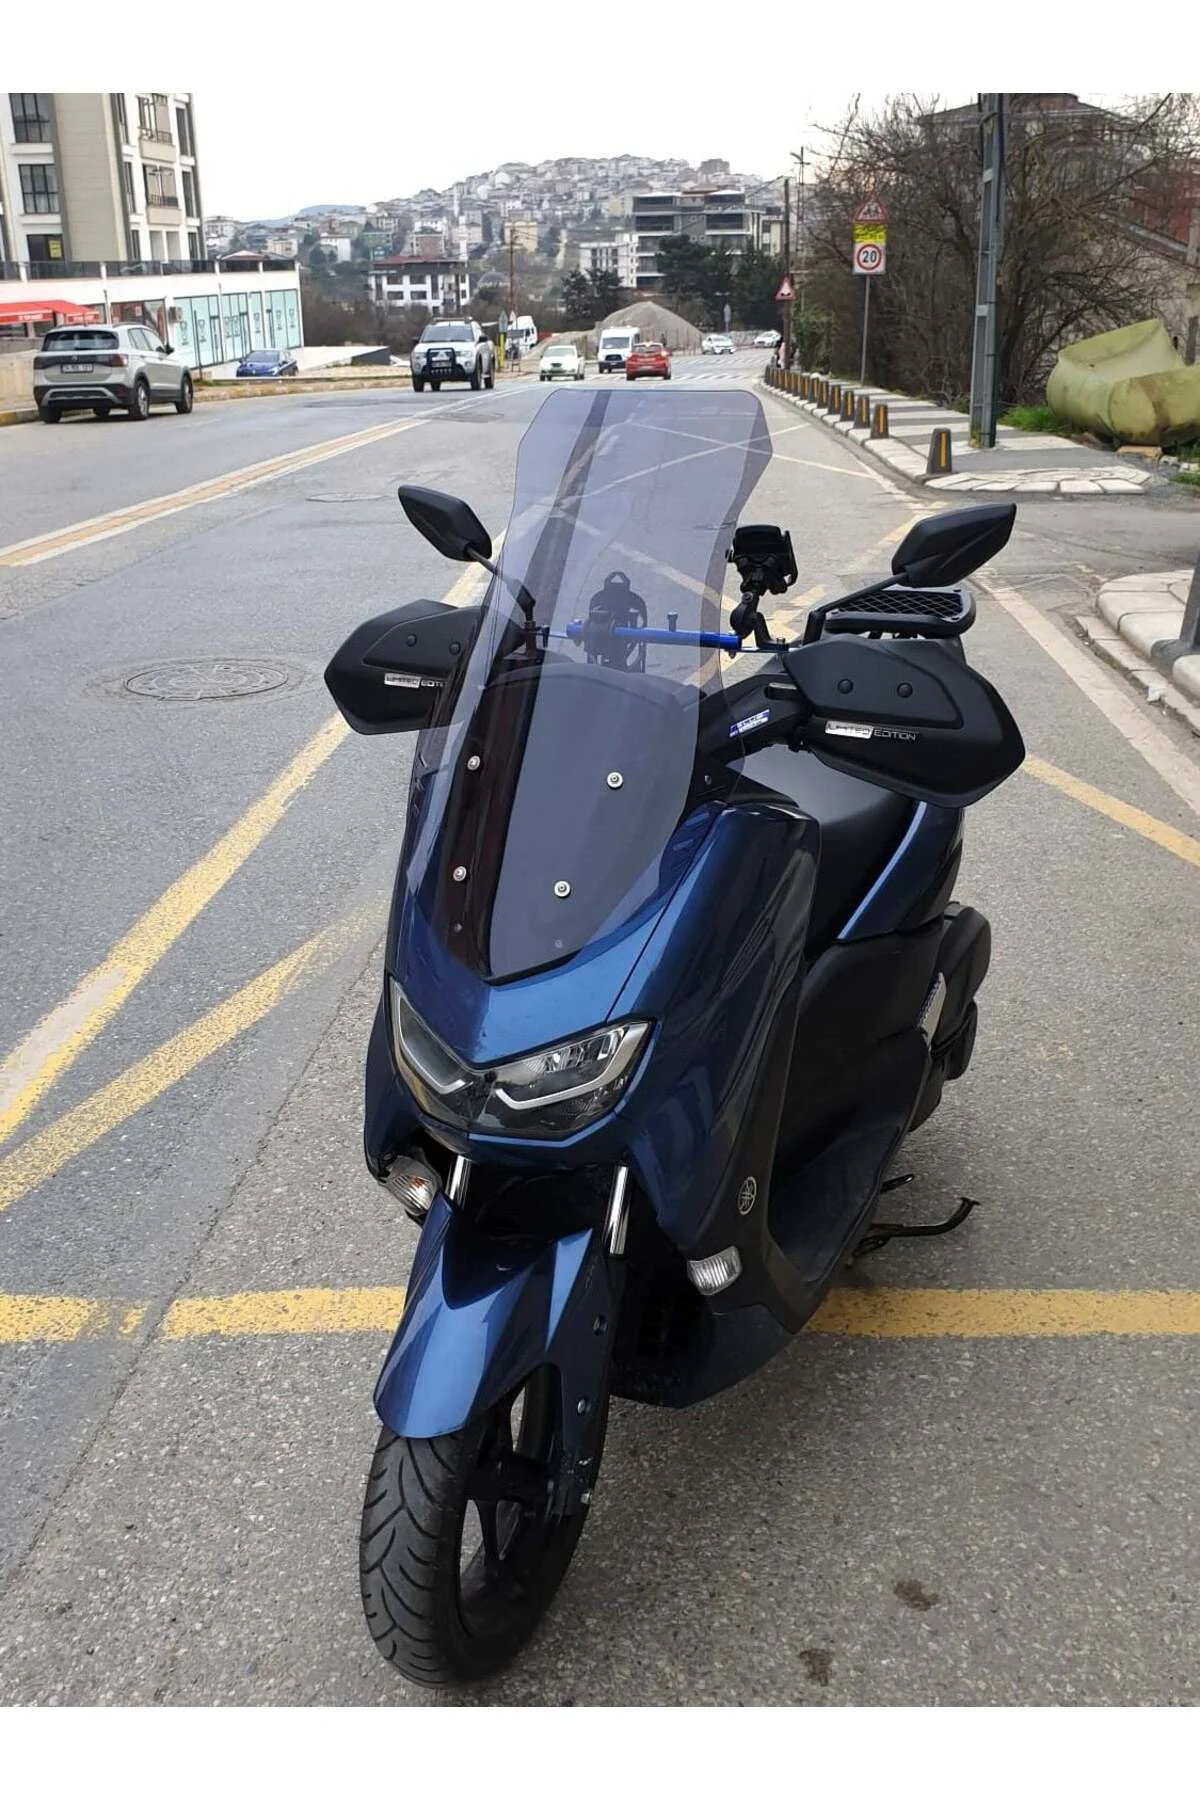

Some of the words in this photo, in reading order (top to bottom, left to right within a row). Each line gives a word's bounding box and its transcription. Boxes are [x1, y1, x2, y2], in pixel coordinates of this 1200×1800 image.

[863, 250, 877, 263] 20
[826, 721, 872, 737] LIMITED
[874, 729, 915, 740] EDITION
